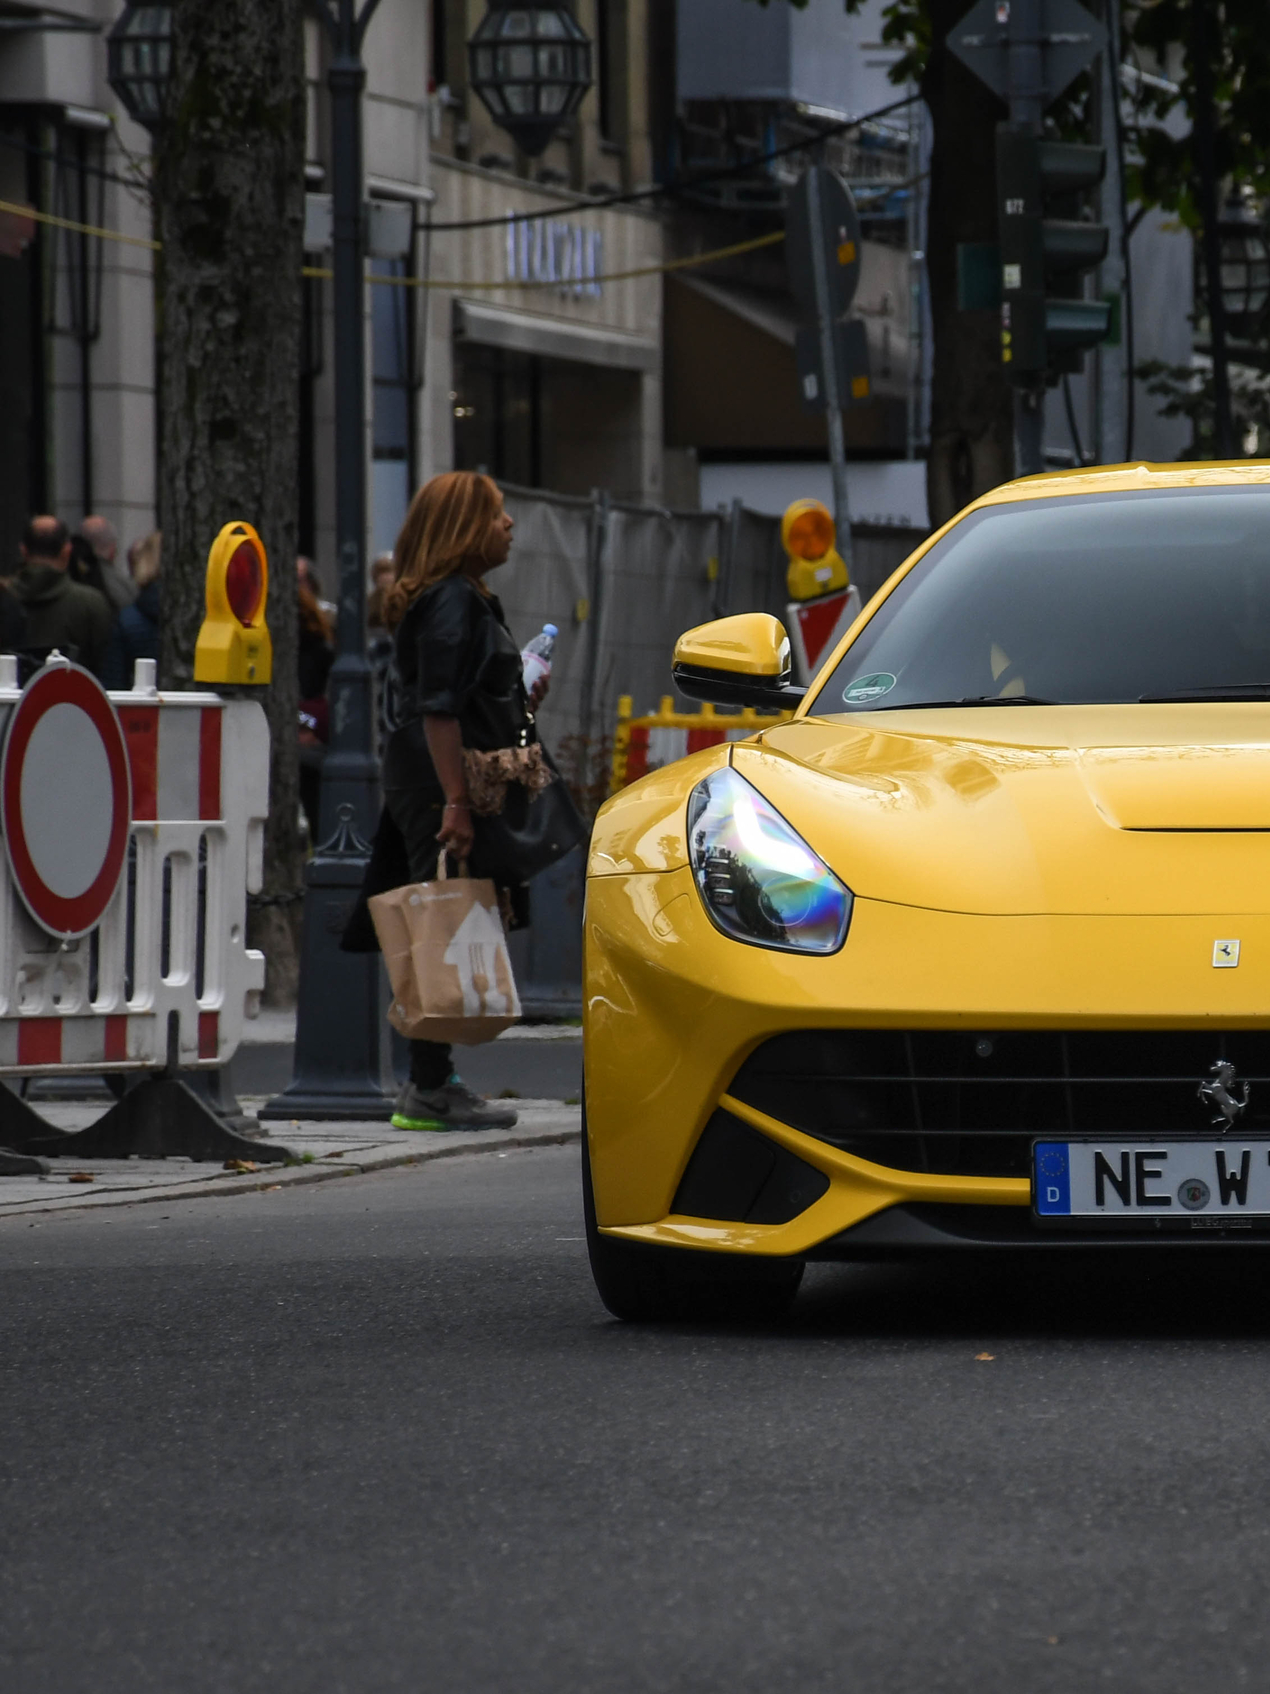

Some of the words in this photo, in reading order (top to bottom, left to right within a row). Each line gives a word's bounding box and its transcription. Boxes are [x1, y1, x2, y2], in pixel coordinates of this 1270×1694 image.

[866, 676, 879, 688] 4
[1094, 1150, 1172, 1207] NE
[1214, 1150, 1251, 1206] W
[1047, 1187, 1059, 1202] D
